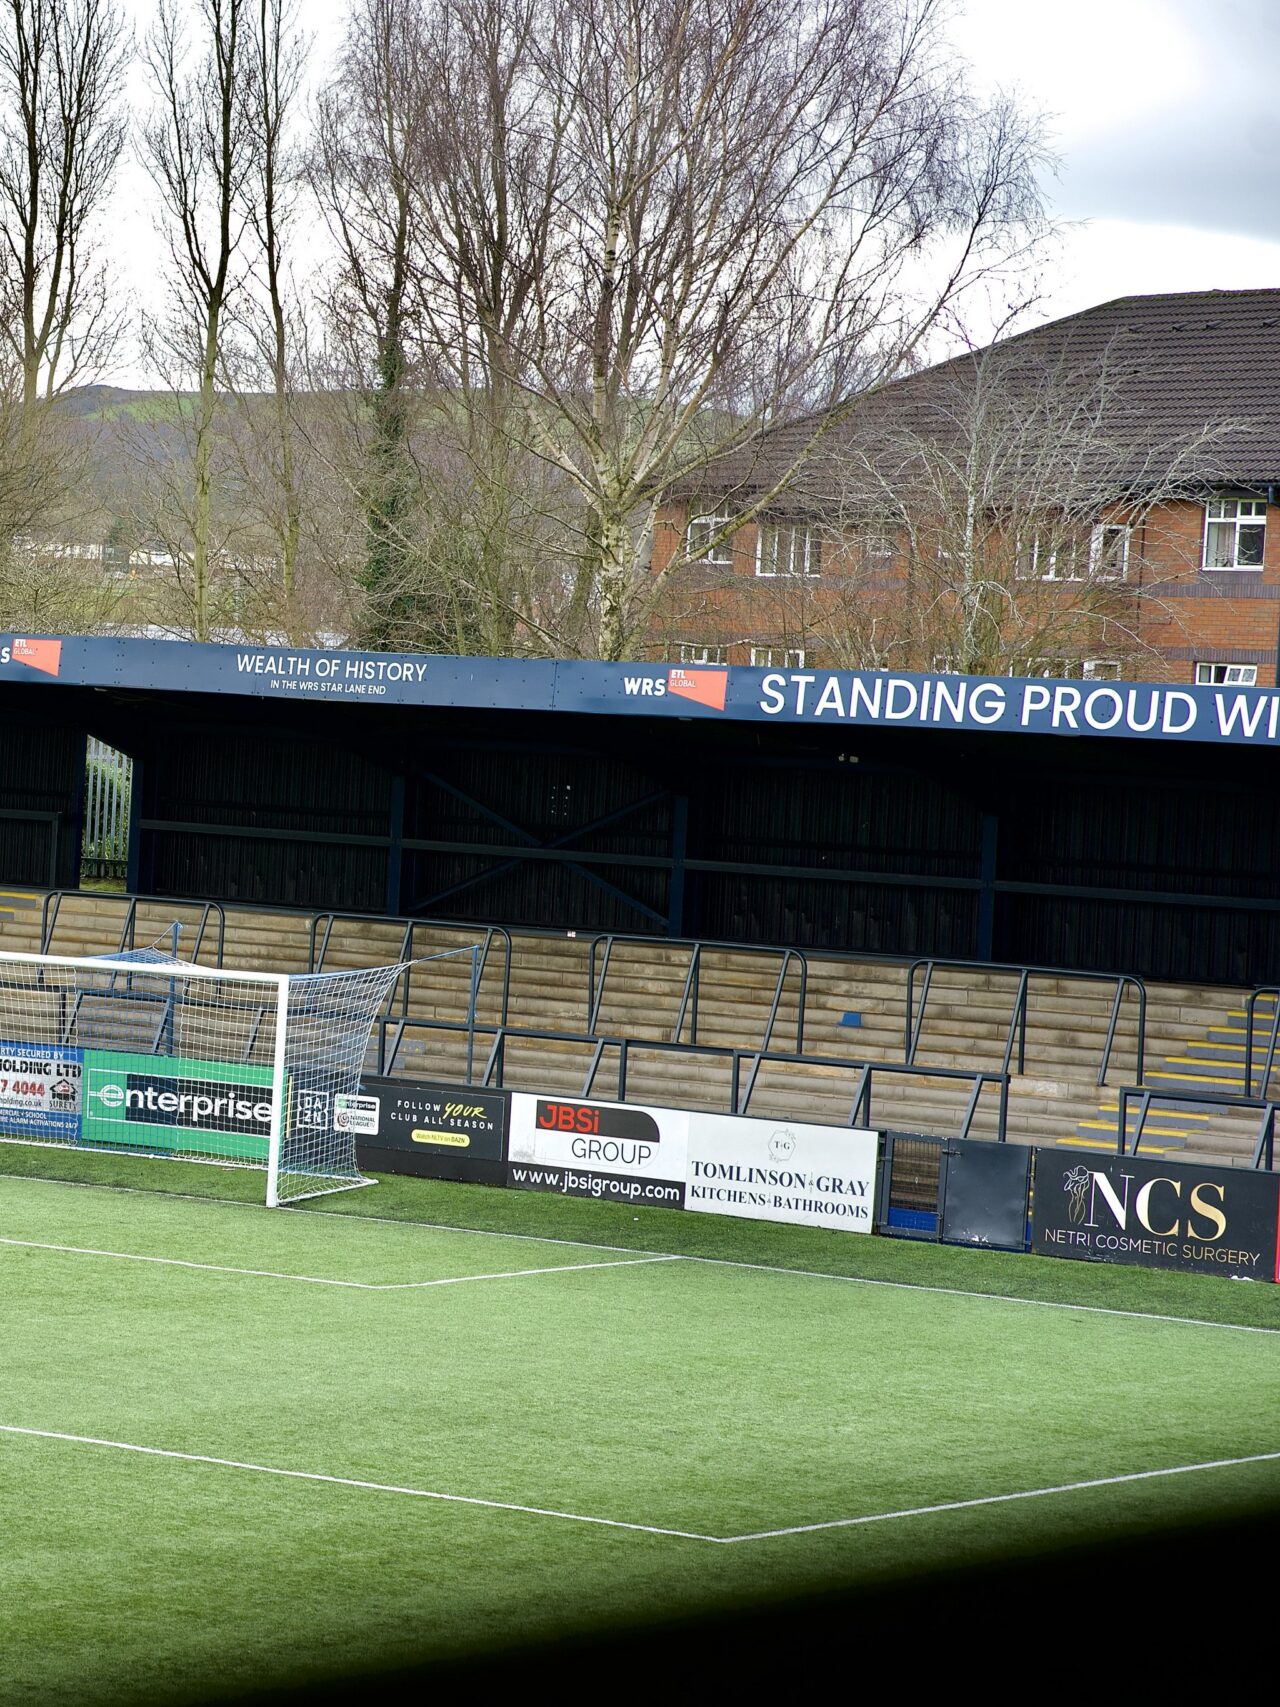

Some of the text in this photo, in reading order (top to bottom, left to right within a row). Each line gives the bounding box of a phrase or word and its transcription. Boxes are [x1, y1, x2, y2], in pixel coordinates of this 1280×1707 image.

[13, 647, 36, 656] GLOBAL
[14, 638, 27, 648] ETL
[237, 654, 427, 682] WEALTH OF HISTORY
[671, 669, 686, 679] ETL
[270, 679, 386, 695] IN THE WRS STAR LANE END
[624, 677, 666, 697] WRS
[670, 679, 696, 688] GLOBAL
[759, 673, 1006, 725] STANDING
[1020, 684, 1198, 734] PROUD
[17, 1049, 51, 1059] SECURED
[53, 1051, 64, 1060] BY
[56, 1064, 81, 1078] LTD
[12, 1080, 46, 1098] 4044
[49, 1100, 76, 1110] SURETY
[99, 1084, 272, 1122] enterprise
[397, 1100, 441, 1112] FOLLOW
[25, 1111, 47, 1120] SCHOOL
[30, 1118, 64, 1128] ACTIVATIONS
[390, 1112, 494, 1130] CLUB ALL SEASON
[538, 1104, 600, 1135] JBSi
[416, 1132, 431, 1140] Watch
[571, 1138, 652, 1166] GROUP
[512, 1168, 680, 1201] www.jbsigroup.com
[692, 1160, 807, 1190] TOMLINSON
[816, 1175, 870, 1197] GRAY
[690, 1186, 766, 1206] KITCHENS
[773, 1196, 868, 1220] BATHROOMS
[1084, 1170, 1227, 1242] NCS
[1044, 1228, 1261, 1266] NETRI COSMETIC SURGERY
